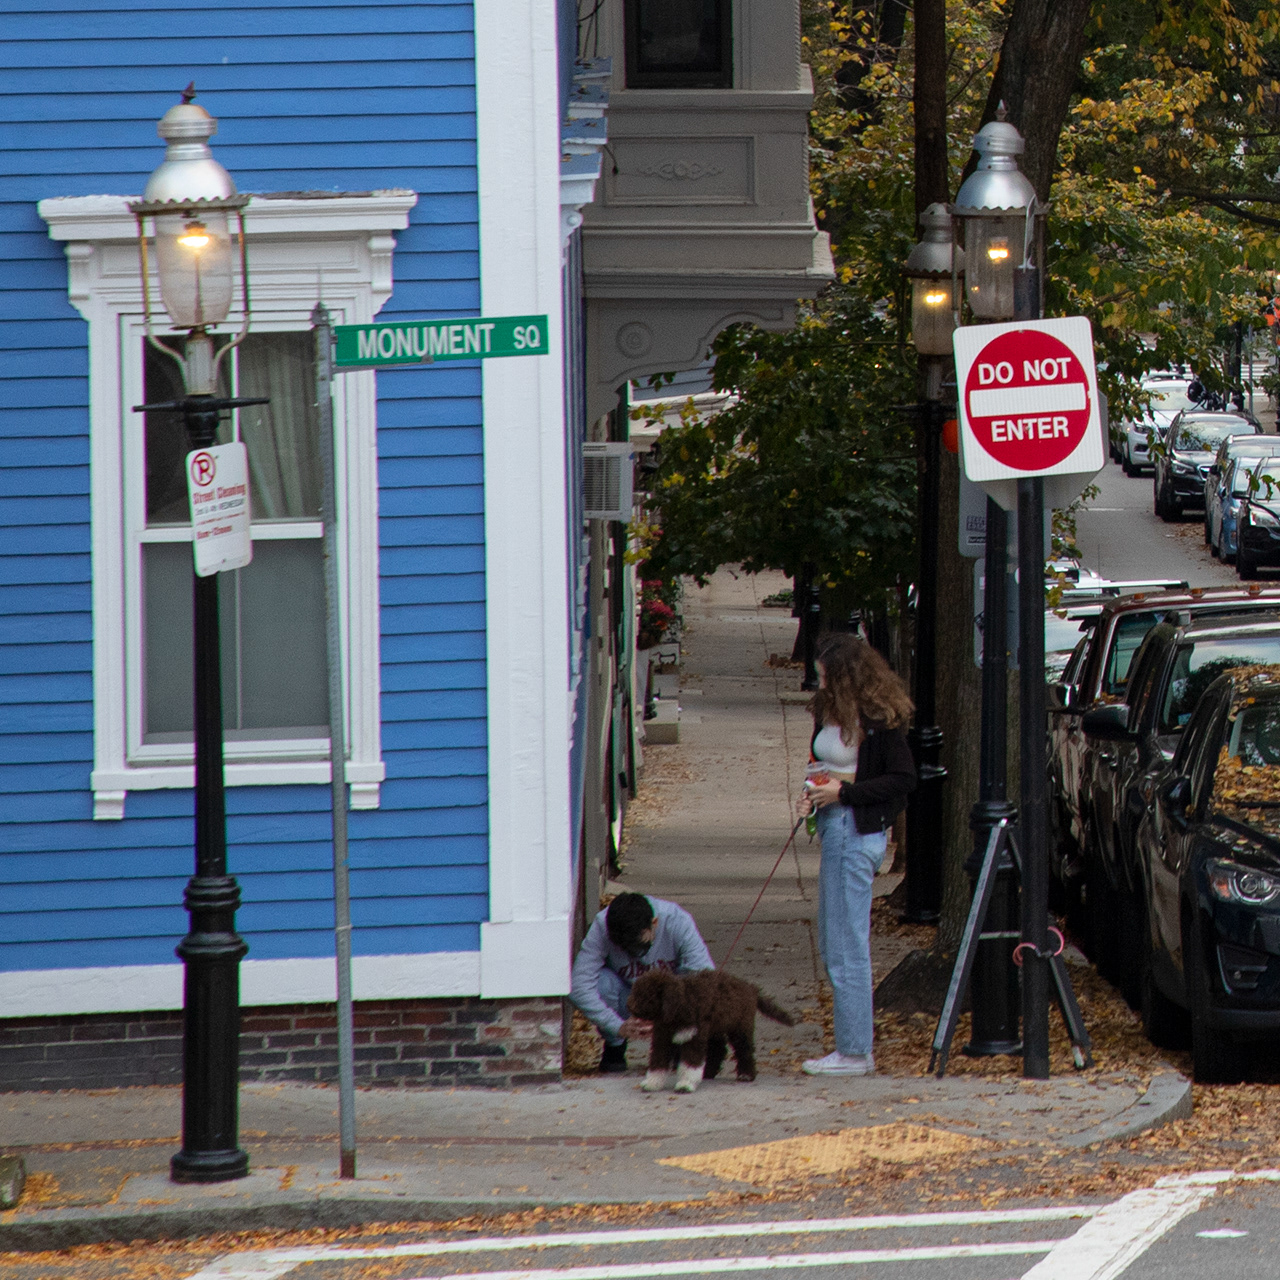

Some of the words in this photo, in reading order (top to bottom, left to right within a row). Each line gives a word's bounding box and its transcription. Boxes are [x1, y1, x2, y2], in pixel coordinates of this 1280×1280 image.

[357, 323, 495, 359] MONUMENT
[513, 325, 541, 350] SQ
[978, 361, 1014, 385] DO
[1023, 357, 1072, 382] NOT
[991, 416, 1069, 442] ENTER
